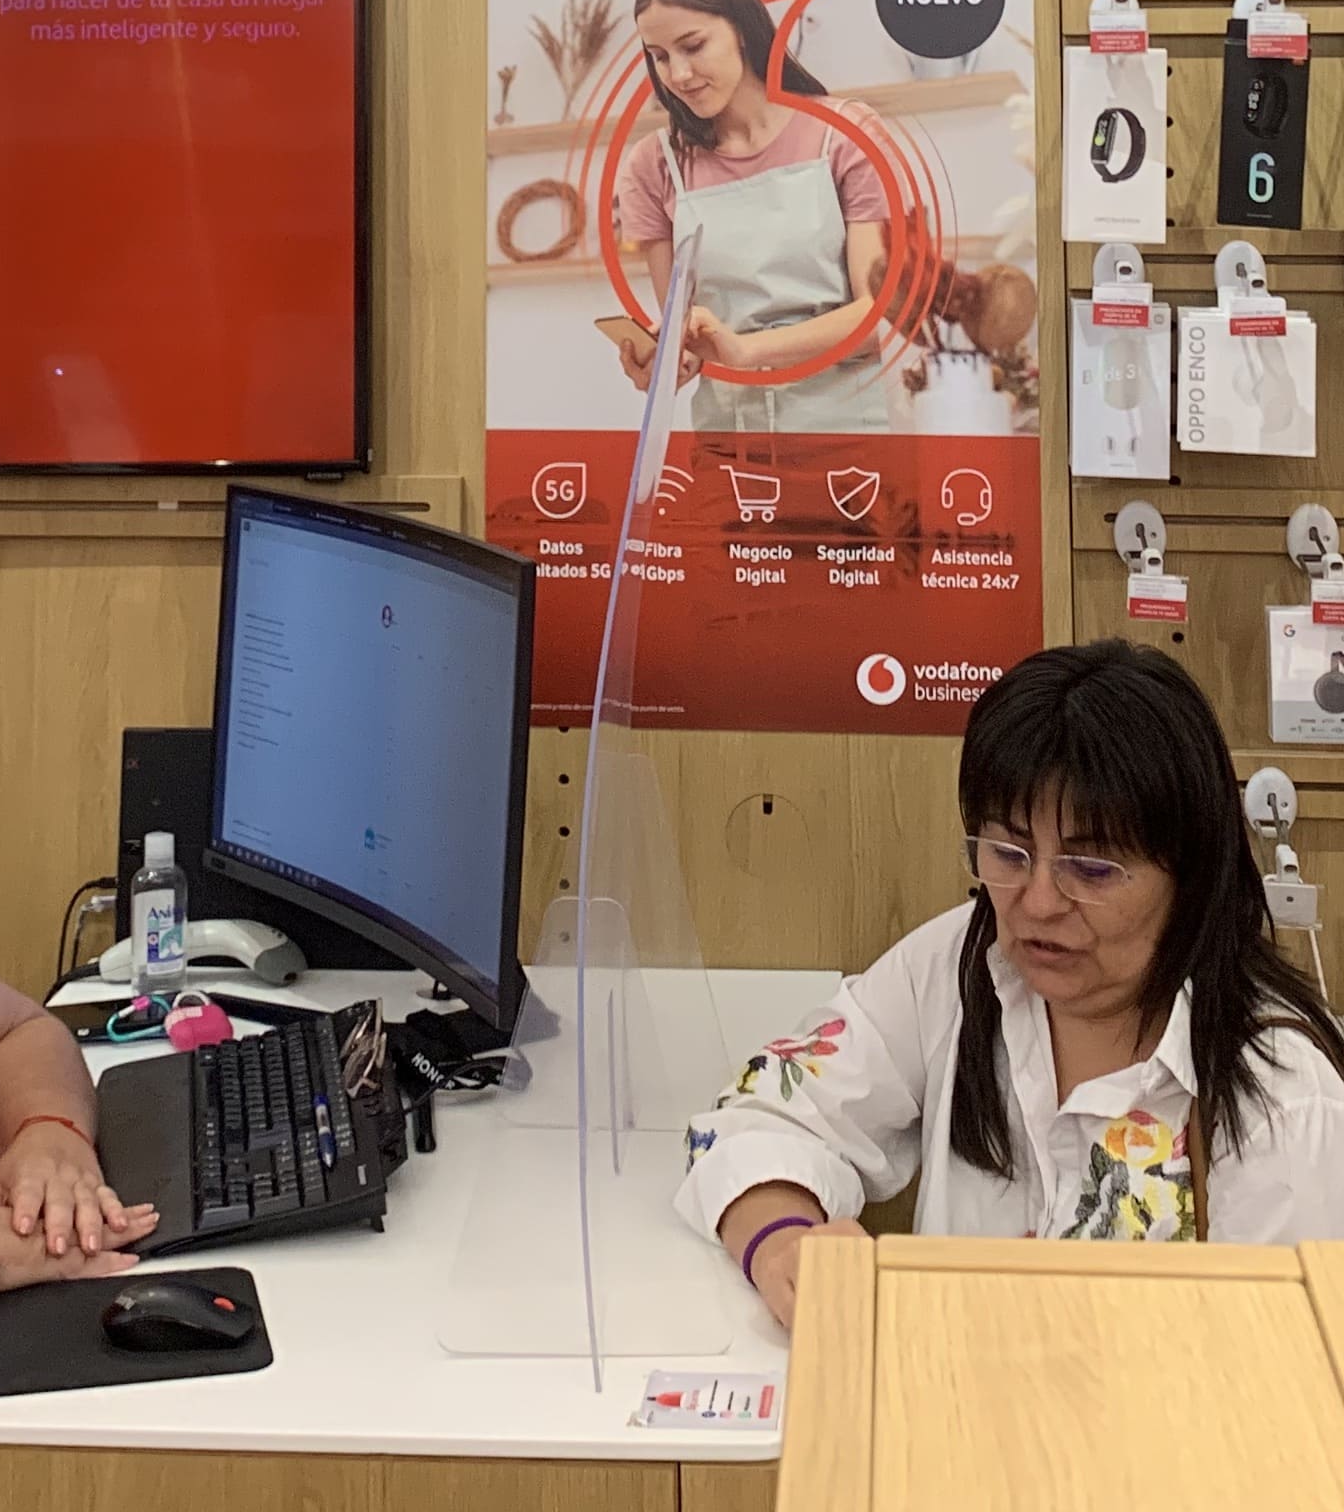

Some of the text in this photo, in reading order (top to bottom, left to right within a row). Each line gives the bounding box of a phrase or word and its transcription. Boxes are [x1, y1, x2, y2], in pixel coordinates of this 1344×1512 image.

[31, 19, 300, 46] más inteligente y seguro.
[1249, 153, 1274, 202] 6
[1189, 326, 1205, 443] OPPO ENCO
[546, 480, 574, 501] 5G
[540, 539, 583, 555] Datos
[642, 541, 682, 558] Fibra
[730, 544, 792, 562] Negocio
[818, 545, 894, 564] Seguridad
[932, 549, 1012, 565] Asistencia
[591, 564, 611, 578] 5G
[736, 568, 786, 586] Digital
[830, 569, 880, 587] Digital
[922, 572, 1019, 589] técnica 24x7
[914, 662, 1002, 680] vodafone
